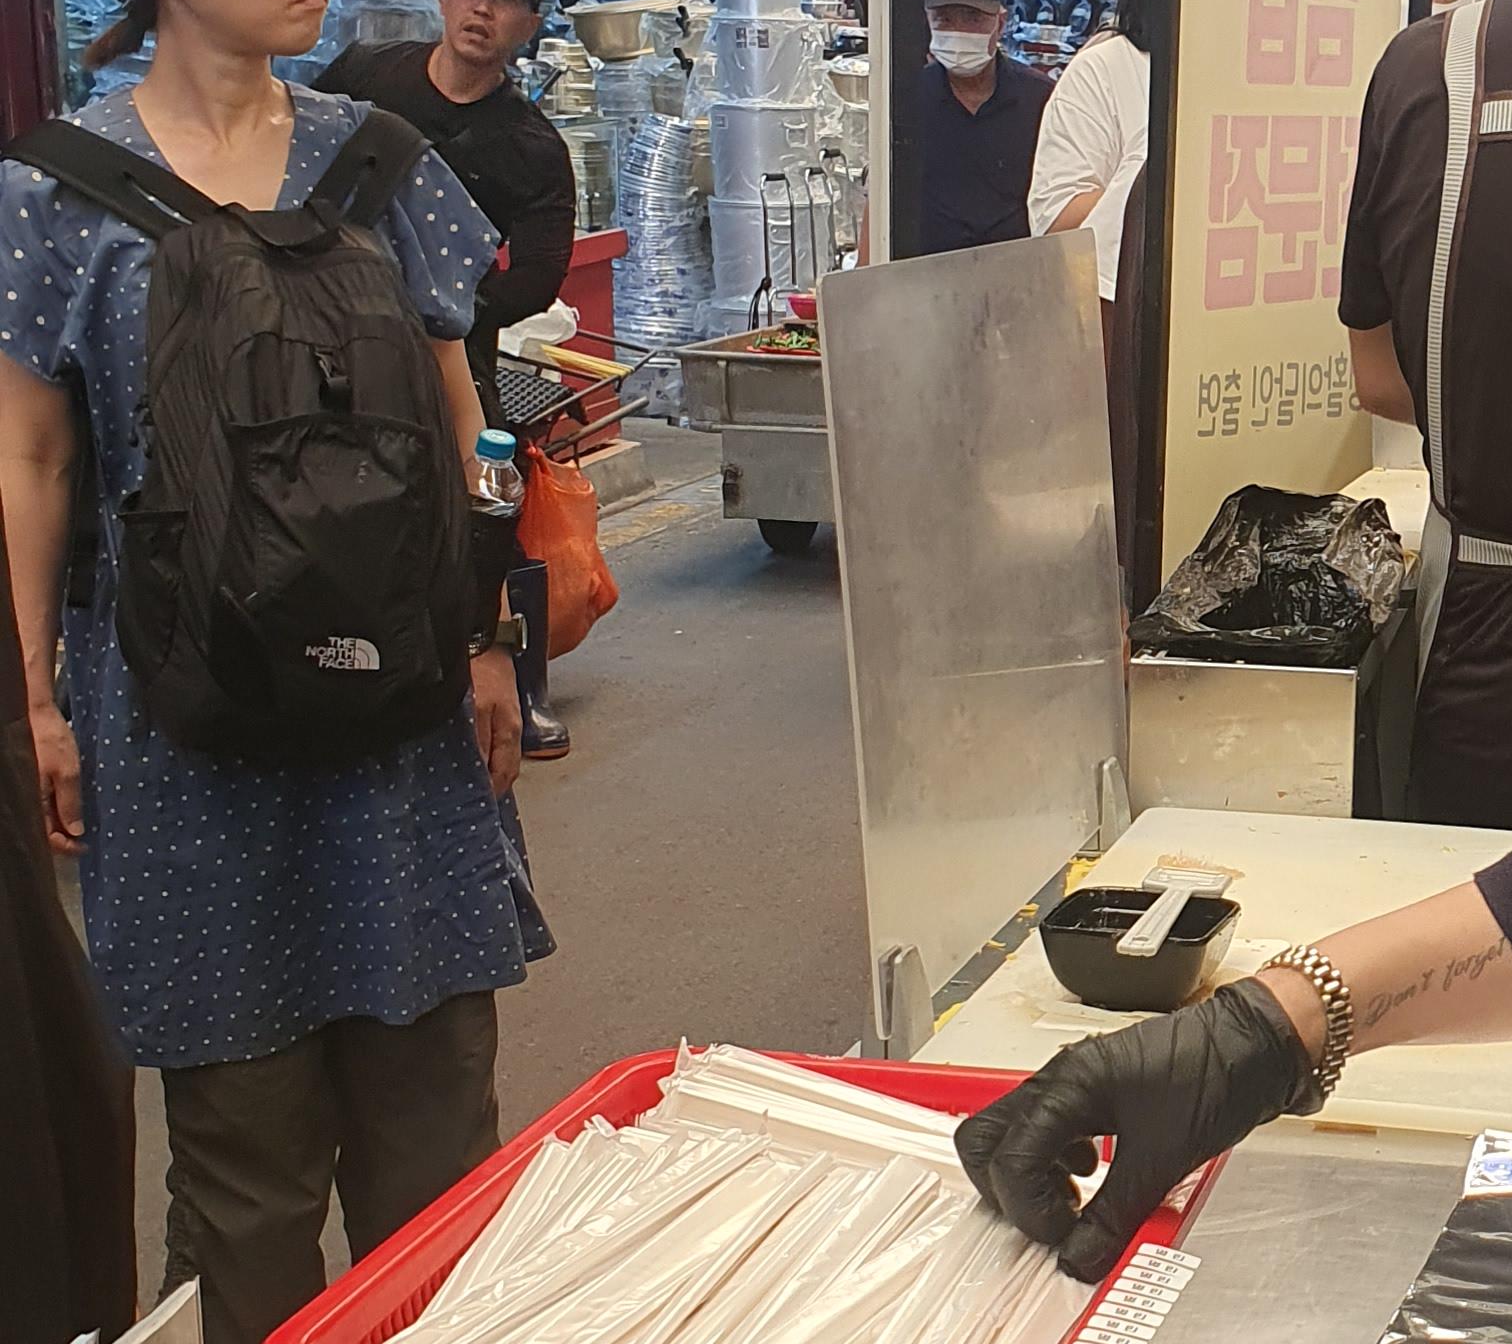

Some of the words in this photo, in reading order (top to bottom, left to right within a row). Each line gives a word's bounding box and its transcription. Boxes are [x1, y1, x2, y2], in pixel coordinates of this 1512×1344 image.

[328, 636, 355, 649] THE
[305, 646, 355, 658] NORTH
[319, 658, 355, 670] FACE
